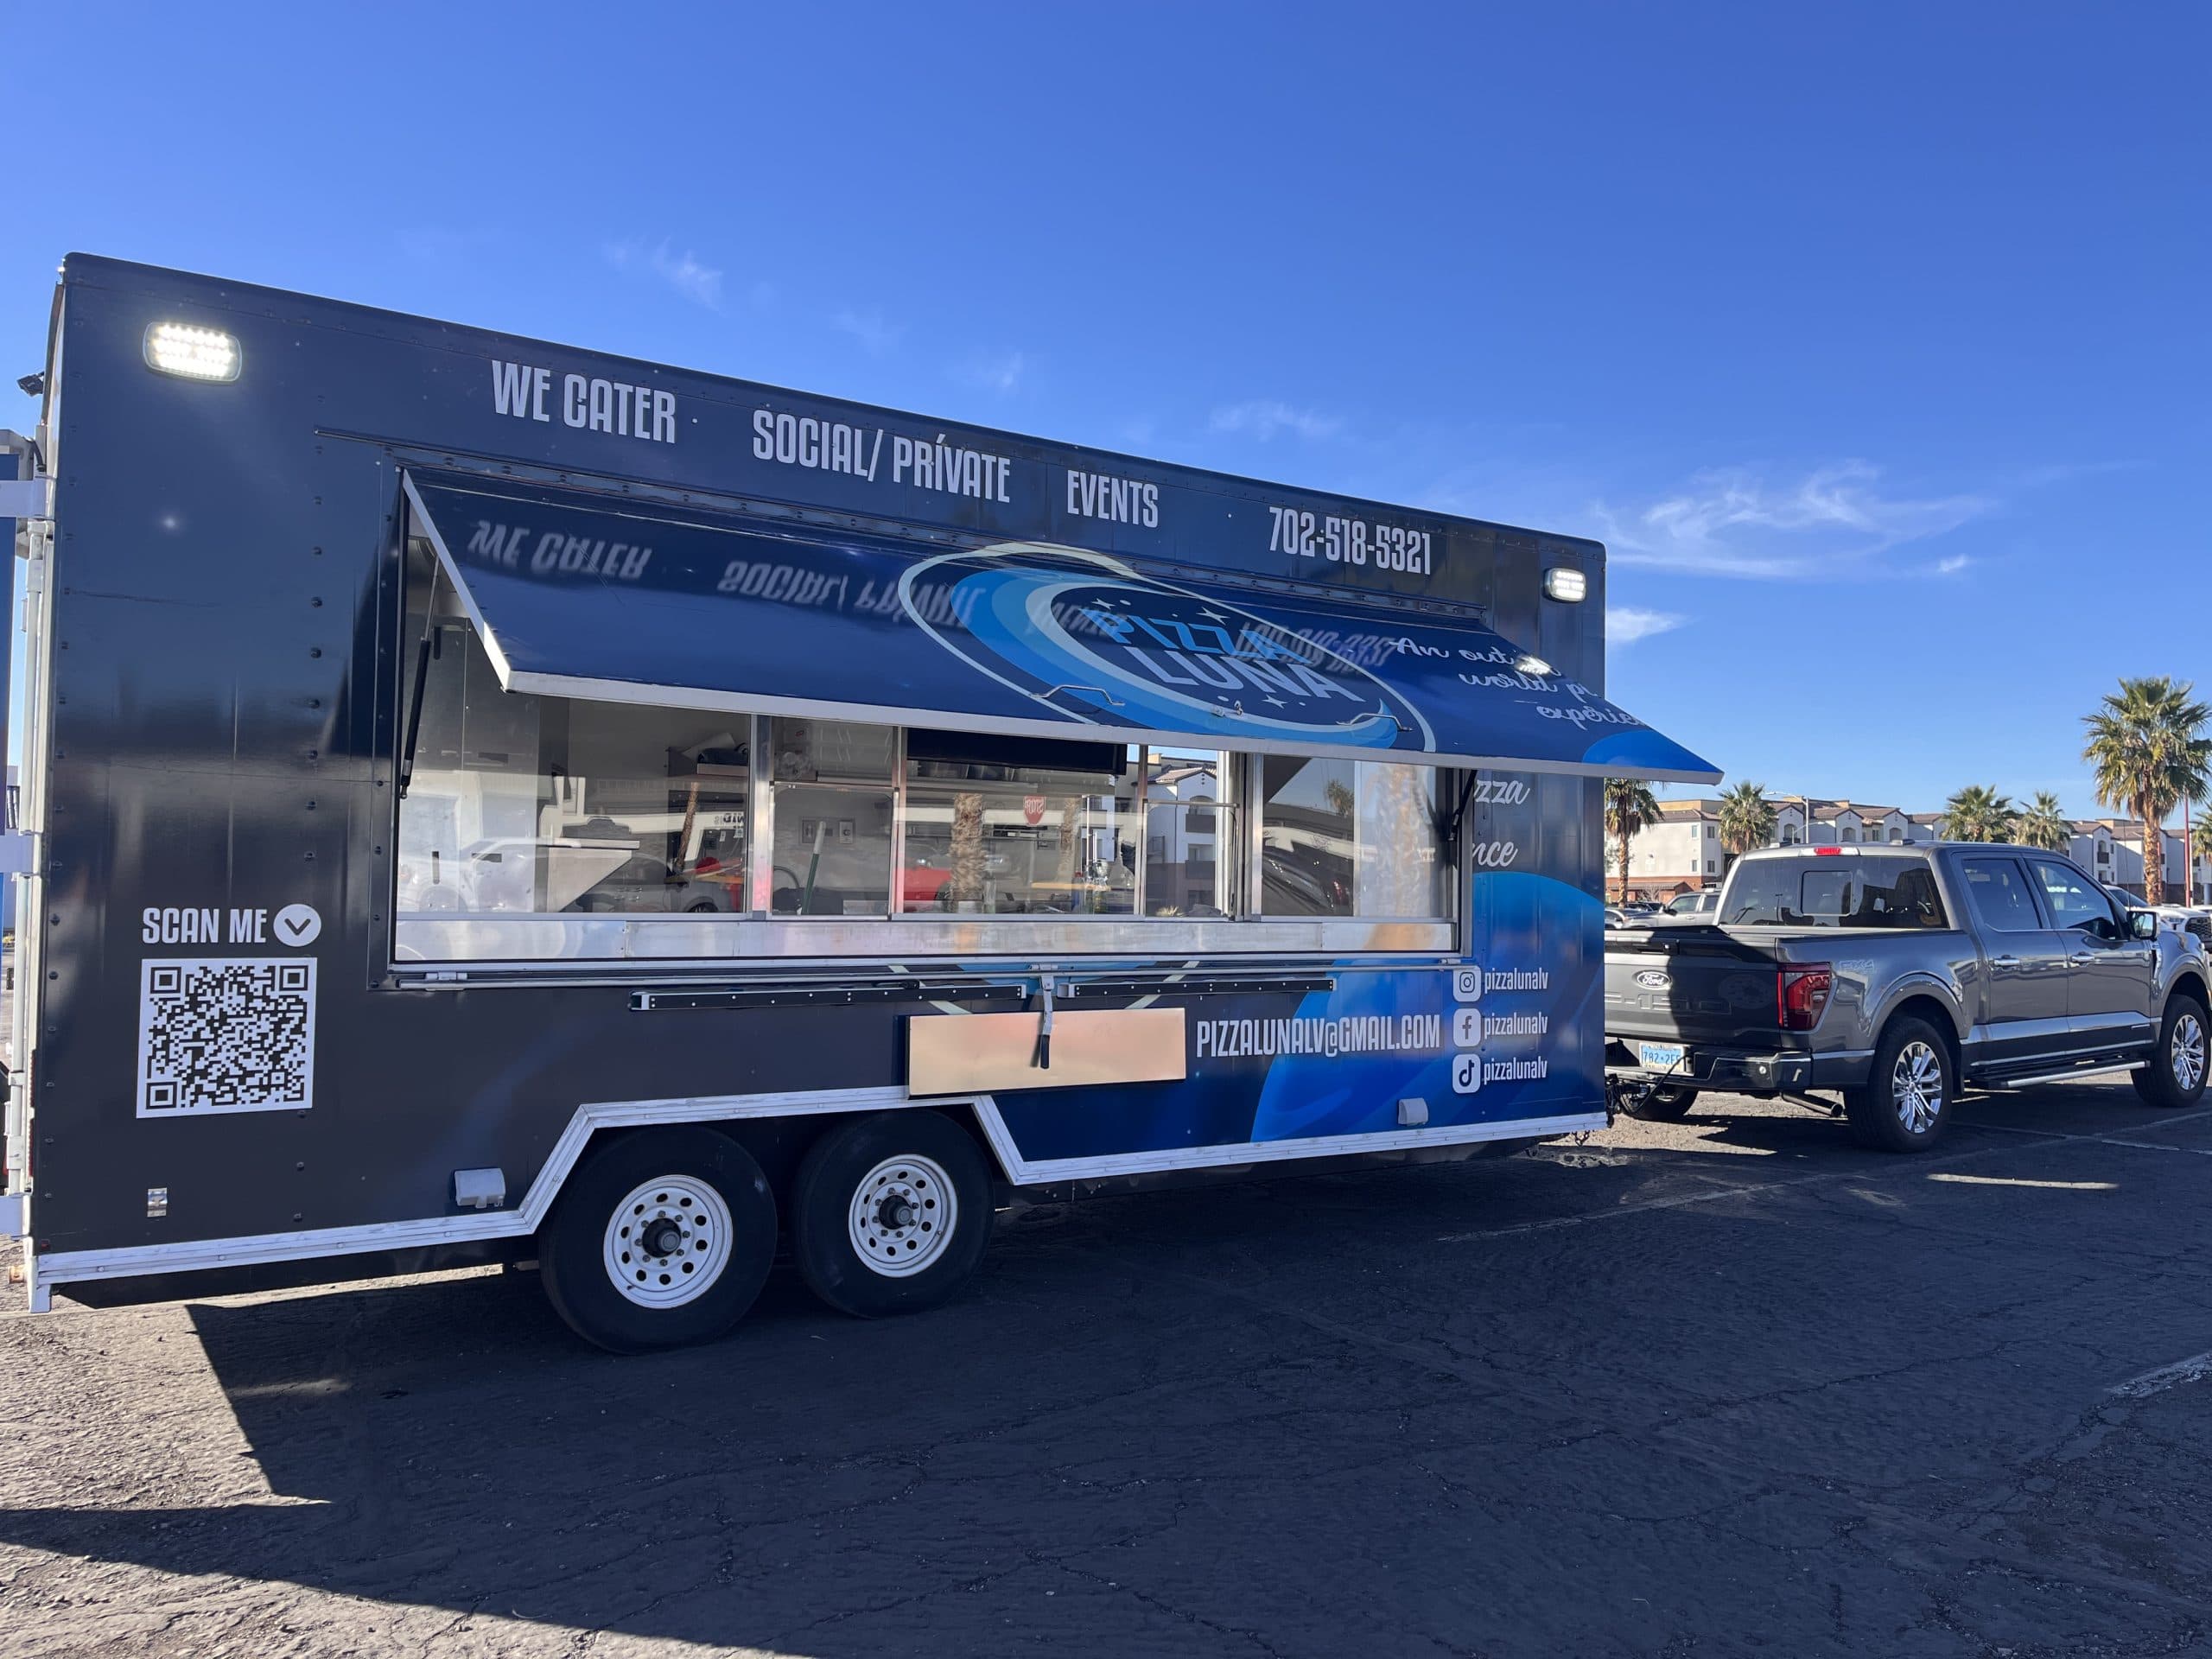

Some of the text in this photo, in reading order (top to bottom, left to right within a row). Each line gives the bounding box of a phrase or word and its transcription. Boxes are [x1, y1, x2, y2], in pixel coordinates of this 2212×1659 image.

[492, 359, 676, 444] WE CATER
[753, 410, 883, 482] SOCIAL/
[1067, 469, 1159, 529] EVENTS
[1268, 505, 1431, 575] 702-518-5321
[1078, 607, 1316, 665] PIZZA
[1389, 637, 1450, 658] An
[1123, 645, 1367, 702] LUNA
[1458, 670, 1559, 693] world
[142, 907, 268, 944] SCAN ME
[1484, 967, 1549, 995] pizzalunalv
[1643, 973, 1665, 986] Ford
[1196, 1014, 1440, 1058] PIZZALUNALV@GMAIL.COM
[1484, 1011, 1549, 1039] pizzalunalv
[1484, 1054, 1548, 1085] pizzalunalv
